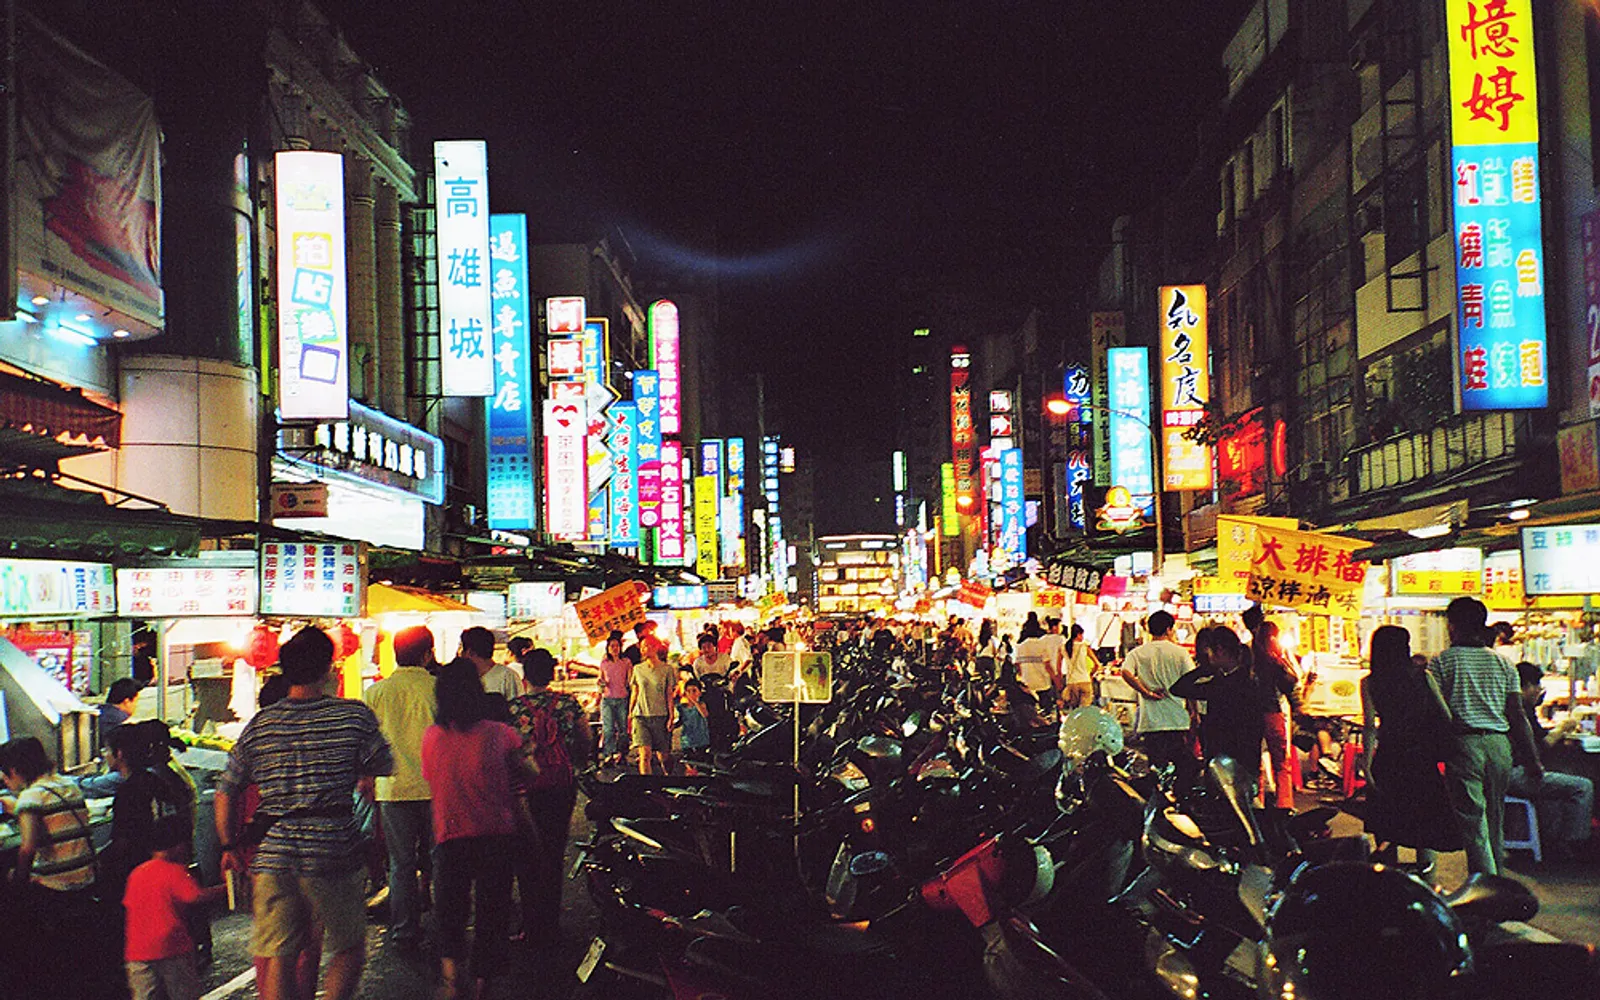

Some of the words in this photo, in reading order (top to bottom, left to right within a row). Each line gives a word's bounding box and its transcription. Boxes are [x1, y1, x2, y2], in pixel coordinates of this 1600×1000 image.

[1460, 0, 1525, 132] 憶婷
[444, 176, 484, 359] 高雄城
[1457, 161, 1488, 390] 紅燒青蛙
[1252, 574, 1360, 613] 涼拌滷味
[1531, 531, 1551, 591] 豆花
